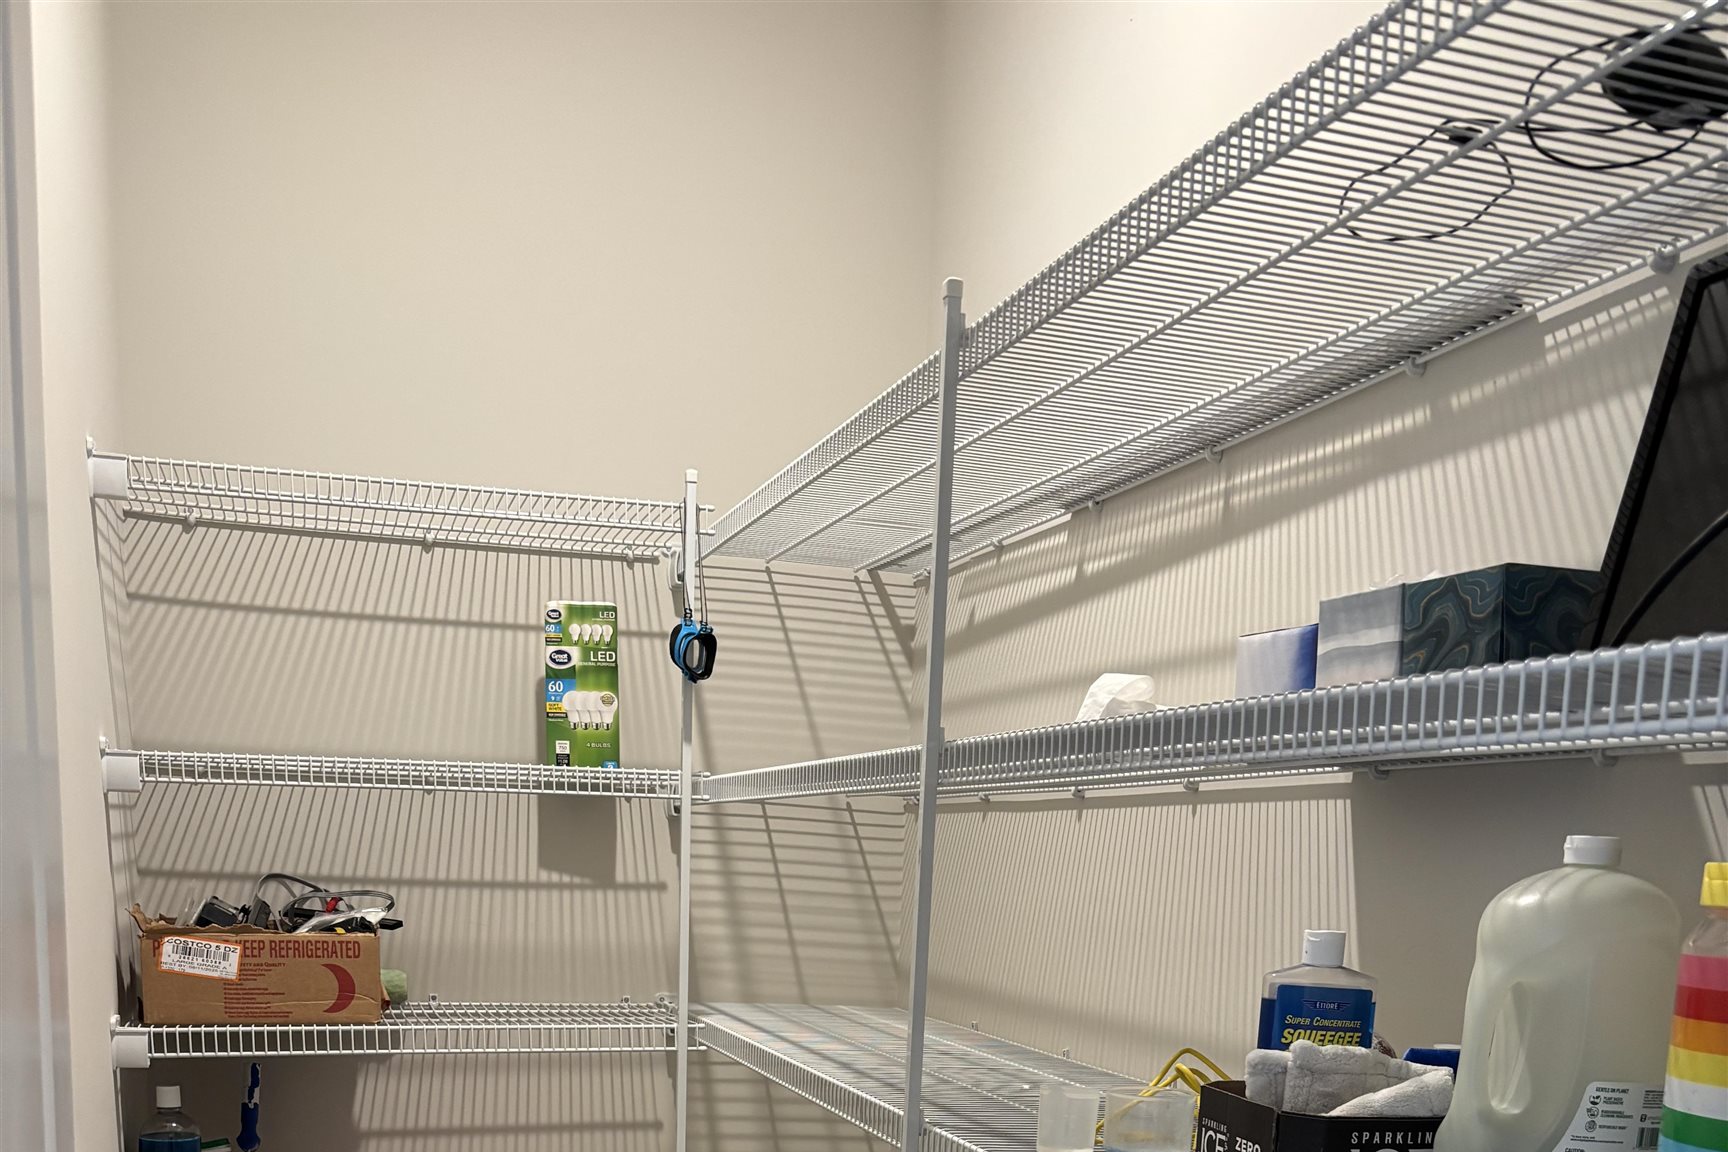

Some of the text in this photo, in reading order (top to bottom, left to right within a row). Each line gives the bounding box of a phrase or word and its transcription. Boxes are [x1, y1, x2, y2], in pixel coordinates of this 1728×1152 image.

[599, 611, 615, 619] LED
[545, 624, 555, 632] 60
[590, 651, 616, 662] LED
[548, 680, 563, 692] 60
[166, 938, 212, 950] COSTCO
[224, 946, 239, 954] DZ
[269, 940, 361, 959] REFRIGERATED
[1316, 1001, 1338, 1010] ETTORE
[1285, 1014, 1361, 1028] SUPER CONCENTRATE
[1281, 1028, 1361, 1046] SQUEEGEE
[1351, 1131, 1433, 1144] SPARKLIN
